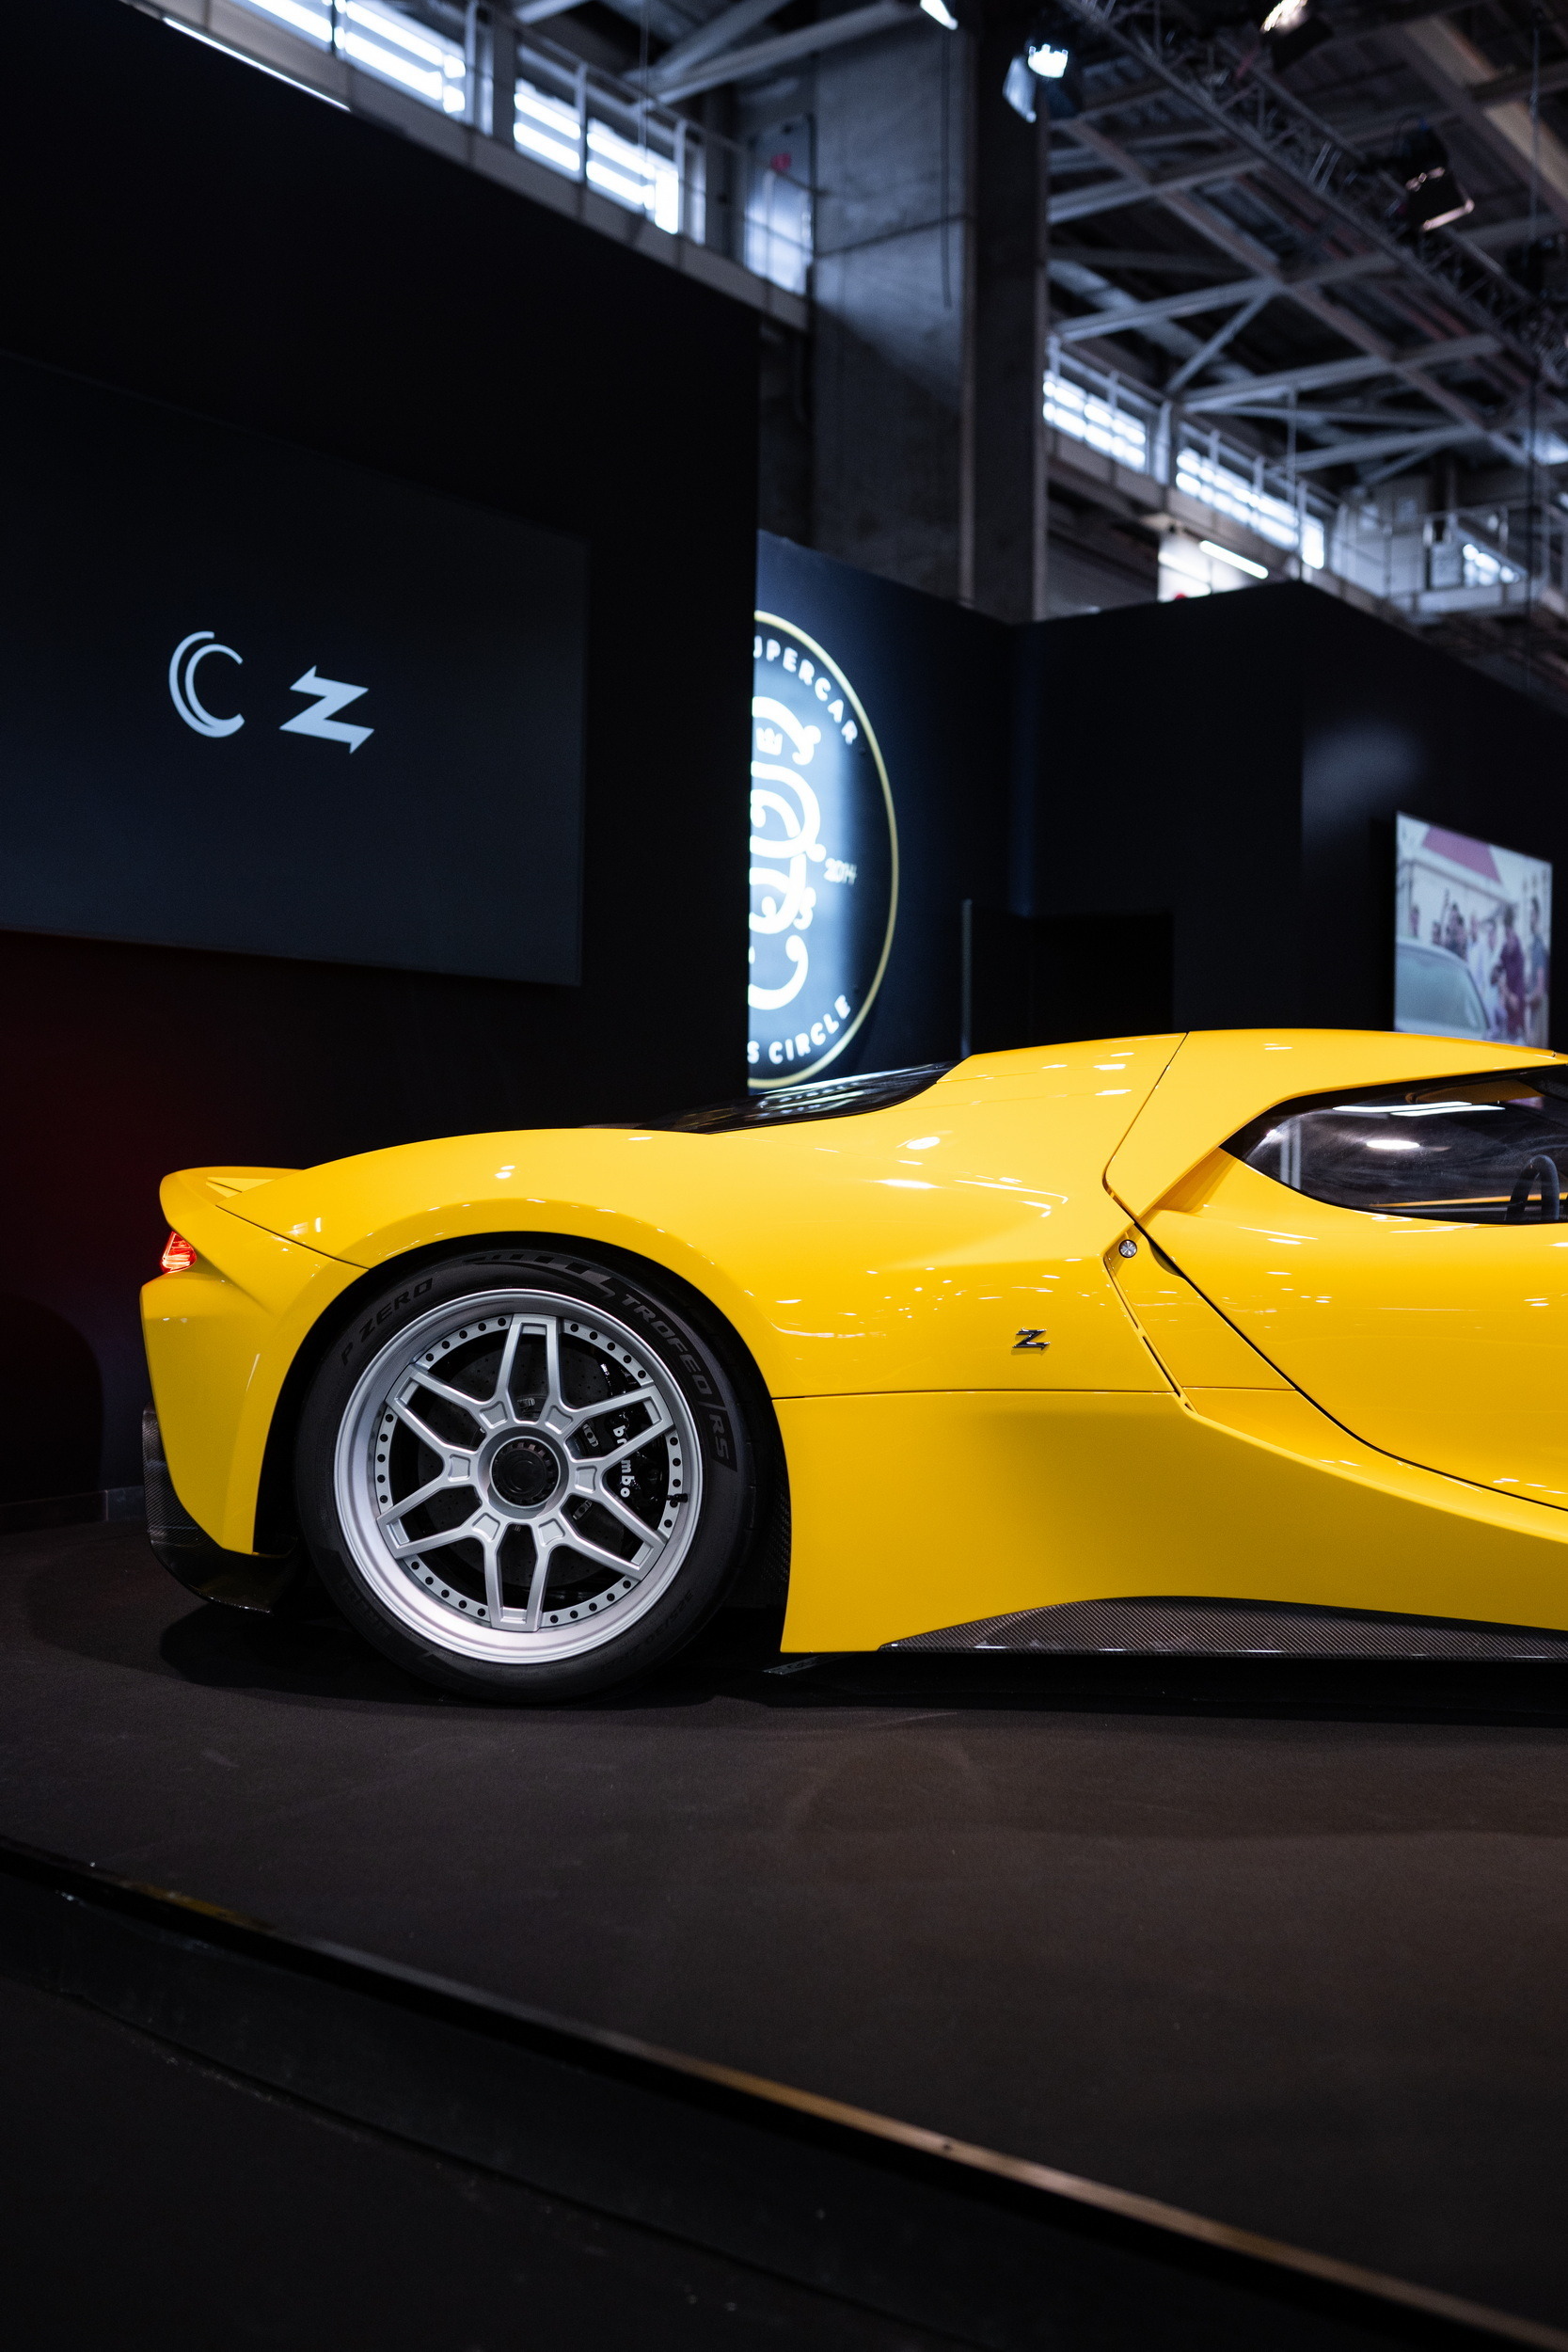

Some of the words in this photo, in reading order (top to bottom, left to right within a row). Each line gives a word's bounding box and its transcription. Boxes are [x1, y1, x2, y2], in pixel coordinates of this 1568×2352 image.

[753, 635, 858, 744] UPERCAR
[768, 994, 851, 1064] CIRCLE
[341, 1341, 355, 1366] P
[358, 1277, 434, 1343] ZERO
[621, 1292, 712, 1397] TROFEO
[709, 1412, 729, 1461] RS
[613, 1425, 631, 1499] brmbo
